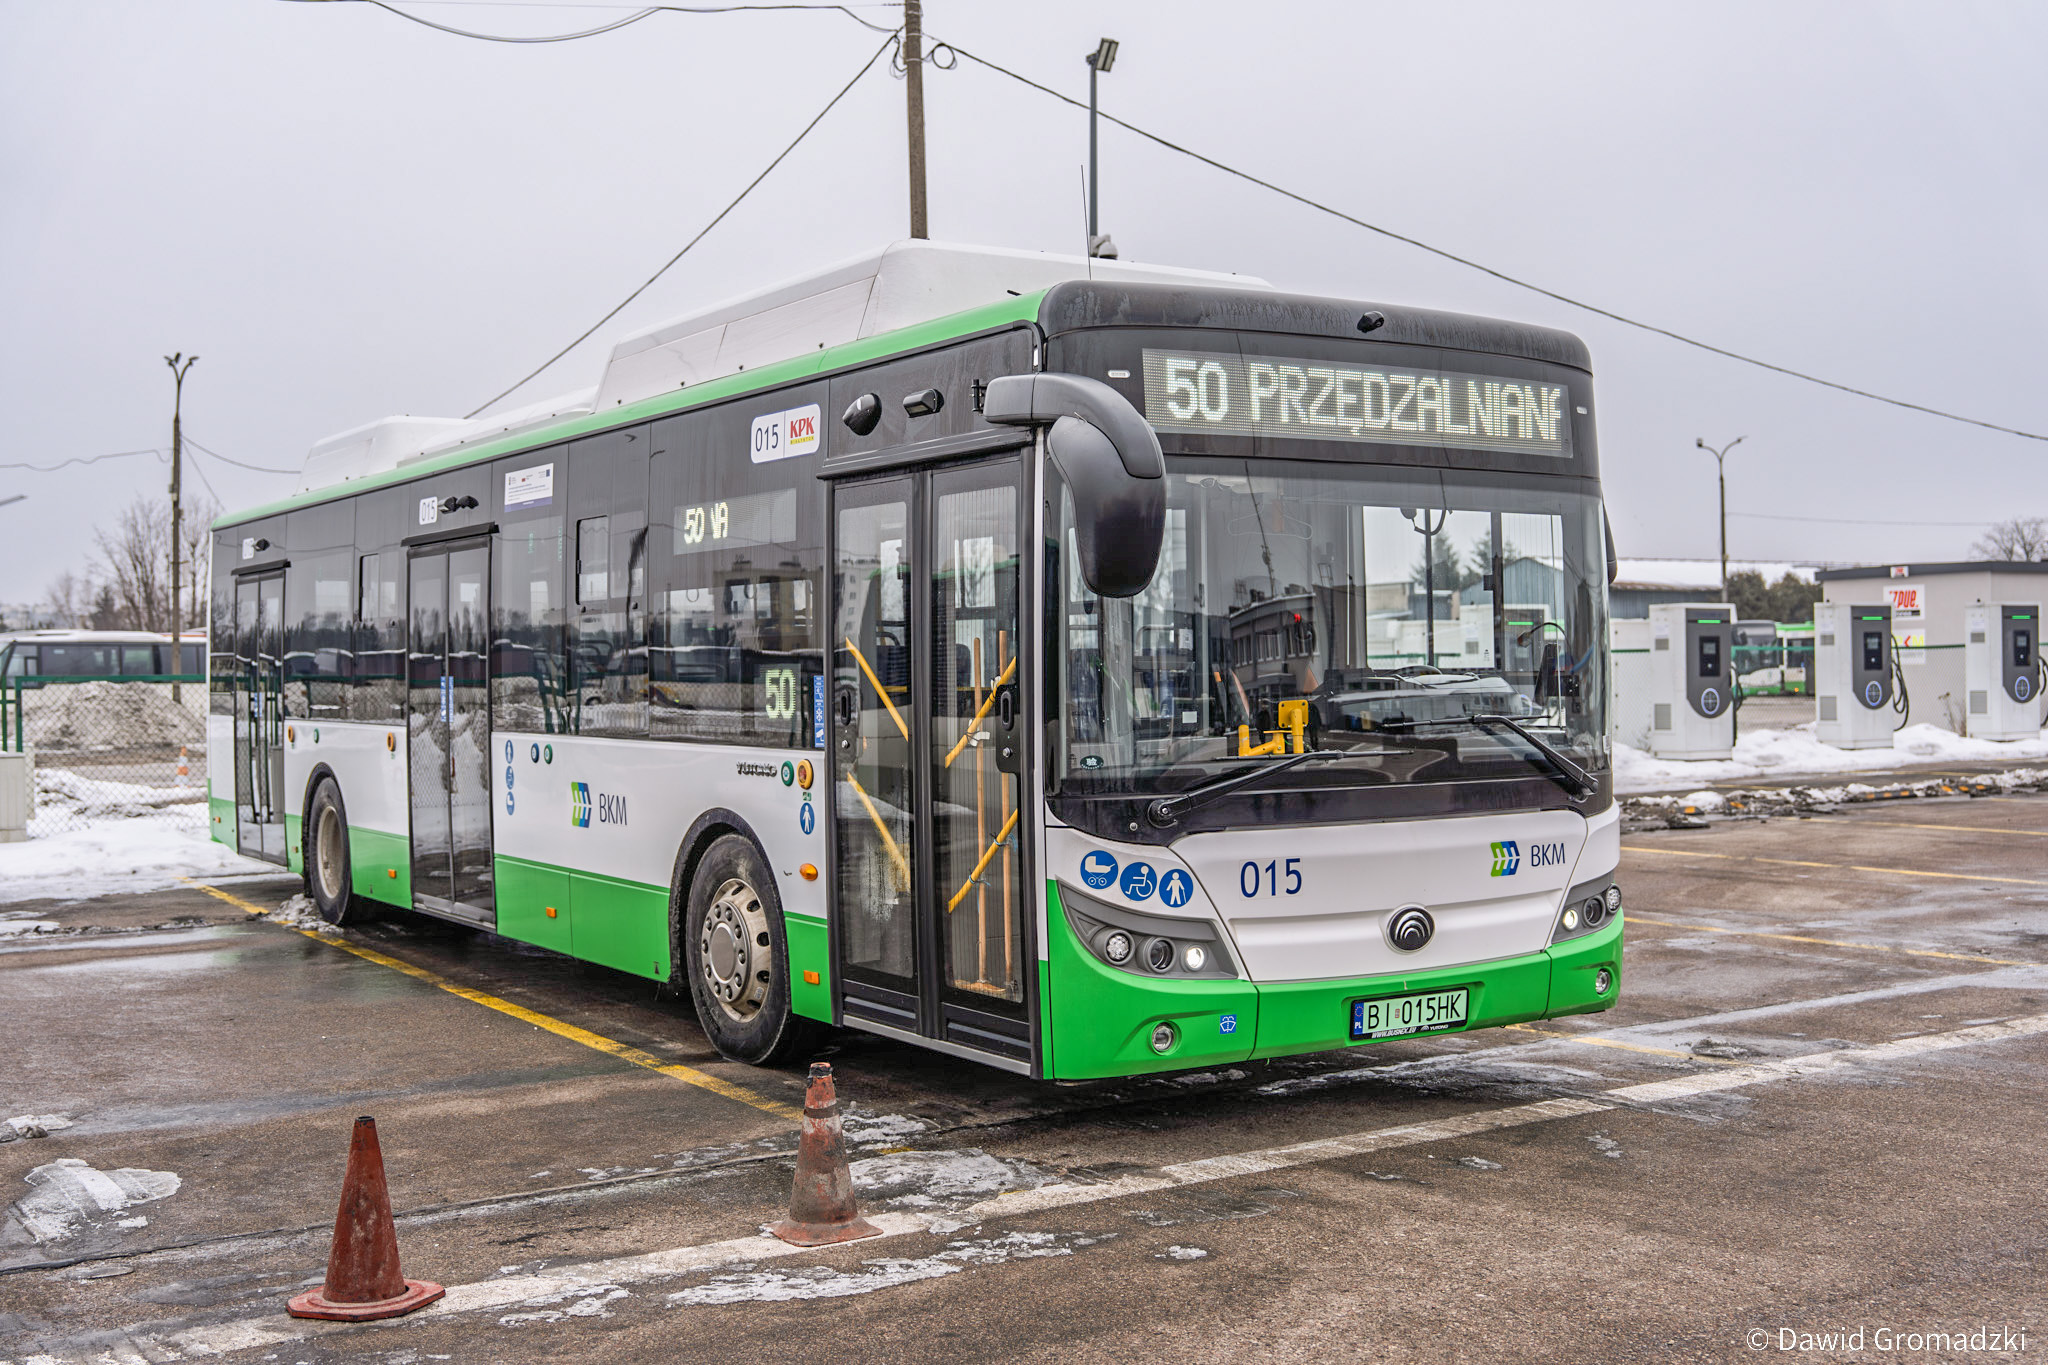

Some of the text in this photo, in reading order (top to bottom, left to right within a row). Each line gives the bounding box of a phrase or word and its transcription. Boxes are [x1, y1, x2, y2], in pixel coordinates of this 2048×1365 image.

[1167, 359, 1228, 420] 50
[755, 423, 779, 452] 015
[790, 416, 814, 438] KPK
[422, 500, 435, 521] 015
[684, 507, 705, 544] 50
[766, 669, 796, 719] 50
[599, 793, 628, 826] BKM
[1531, 843, 1566, 867] BKM
[1240, 858, 1302, 898] 015
[1368, 993, 1461, 1029] BI 015HK
